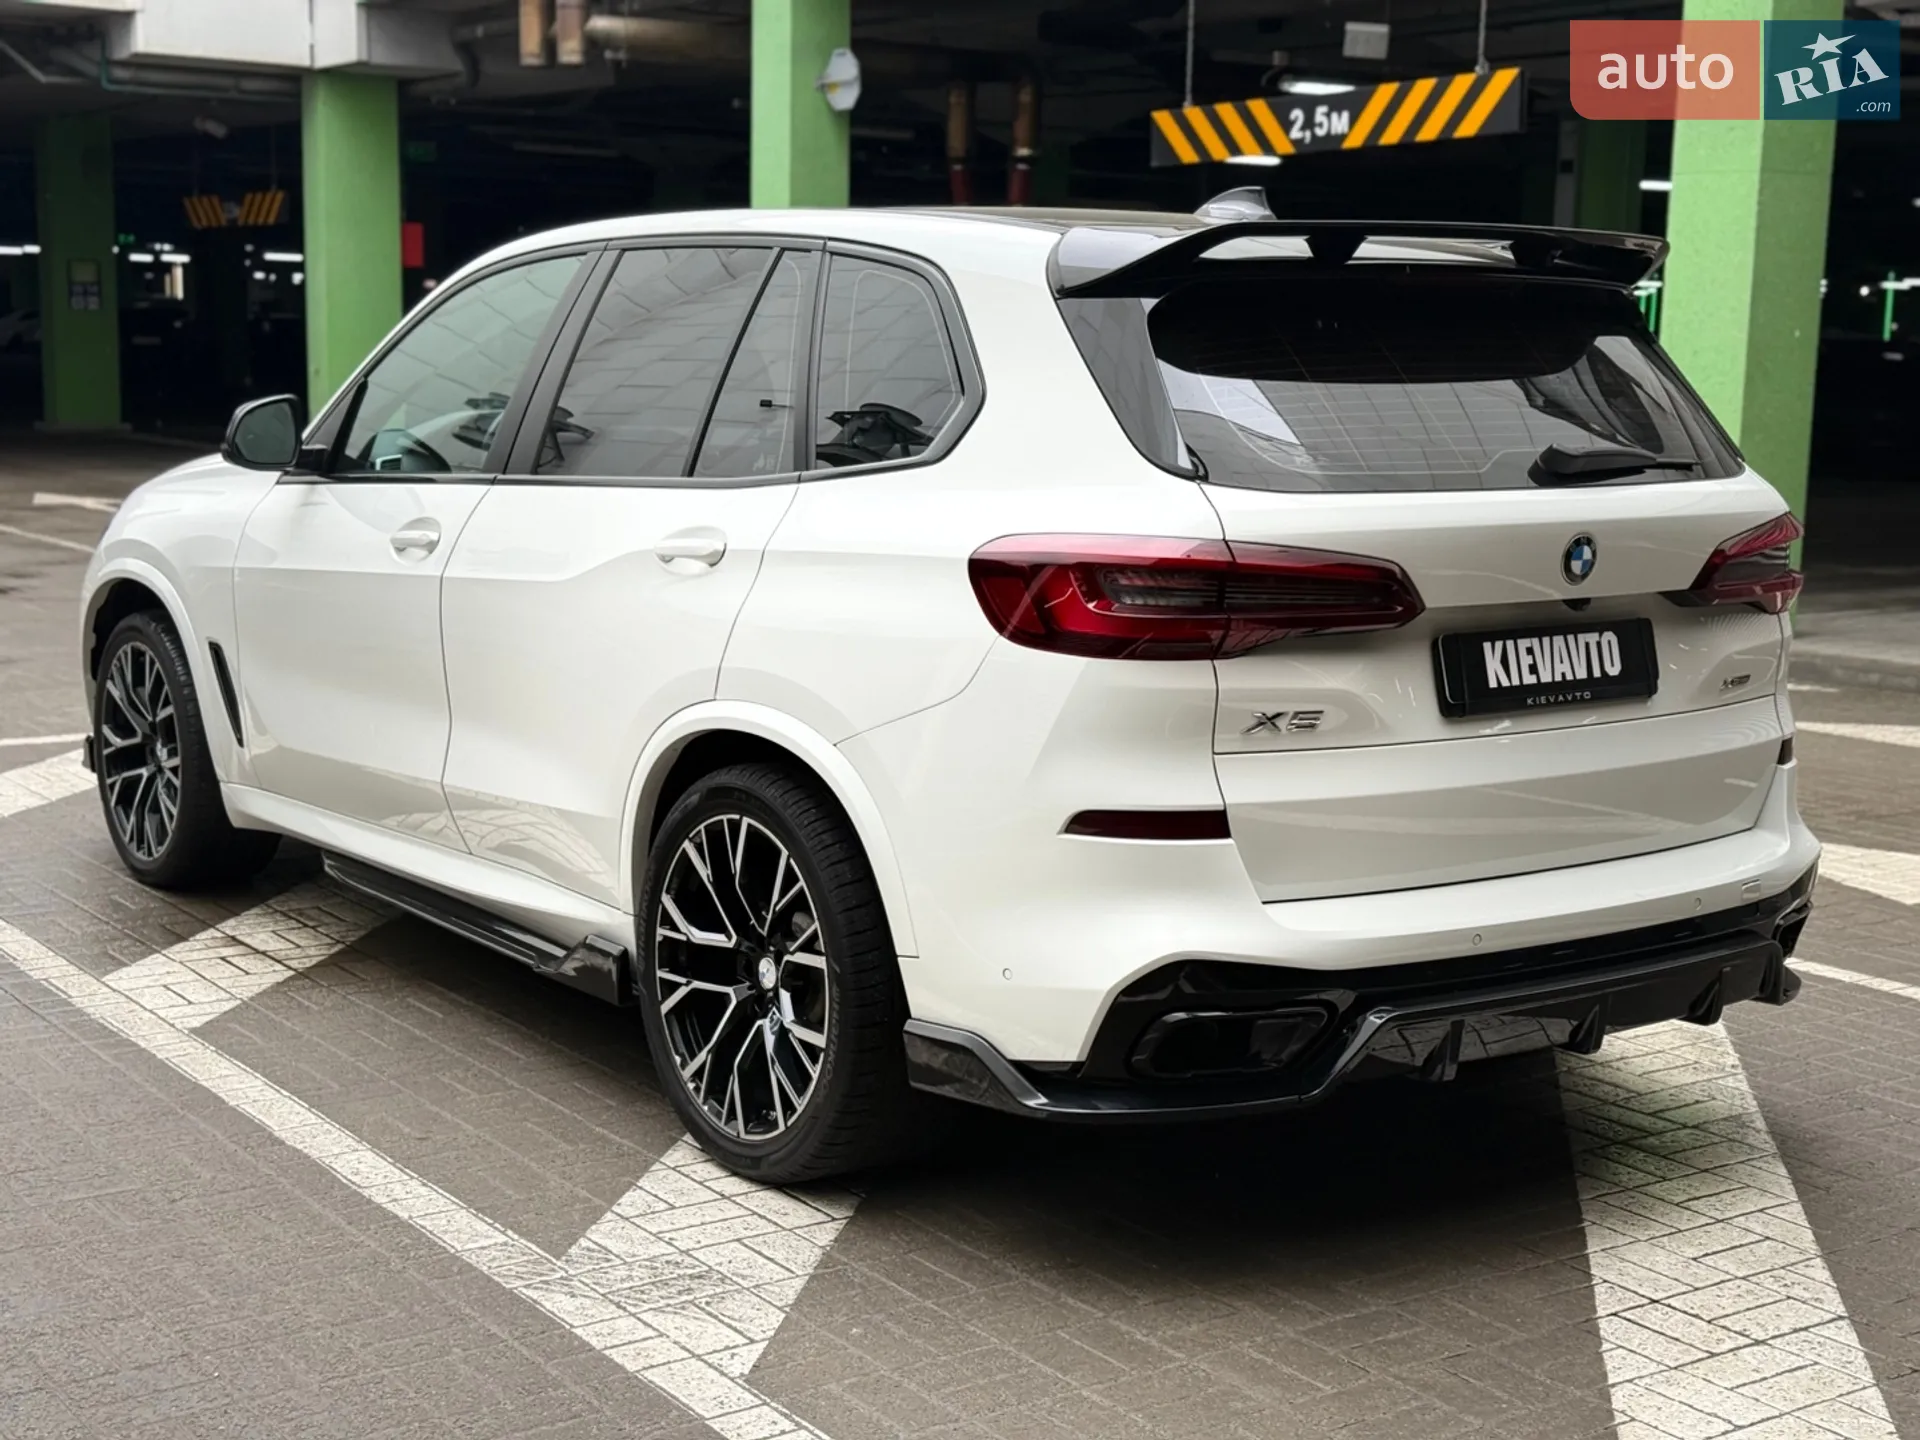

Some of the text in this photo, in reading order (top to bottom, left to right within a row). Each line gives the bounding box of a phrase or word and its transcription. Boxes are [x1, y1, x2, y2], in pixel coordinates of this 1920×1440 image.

[1482, 630, 1623, 689] KIEVAVTO
[1526, 691, 1592, 706] KIEVAVTO
[1240, 709, 1325, 735] X5
